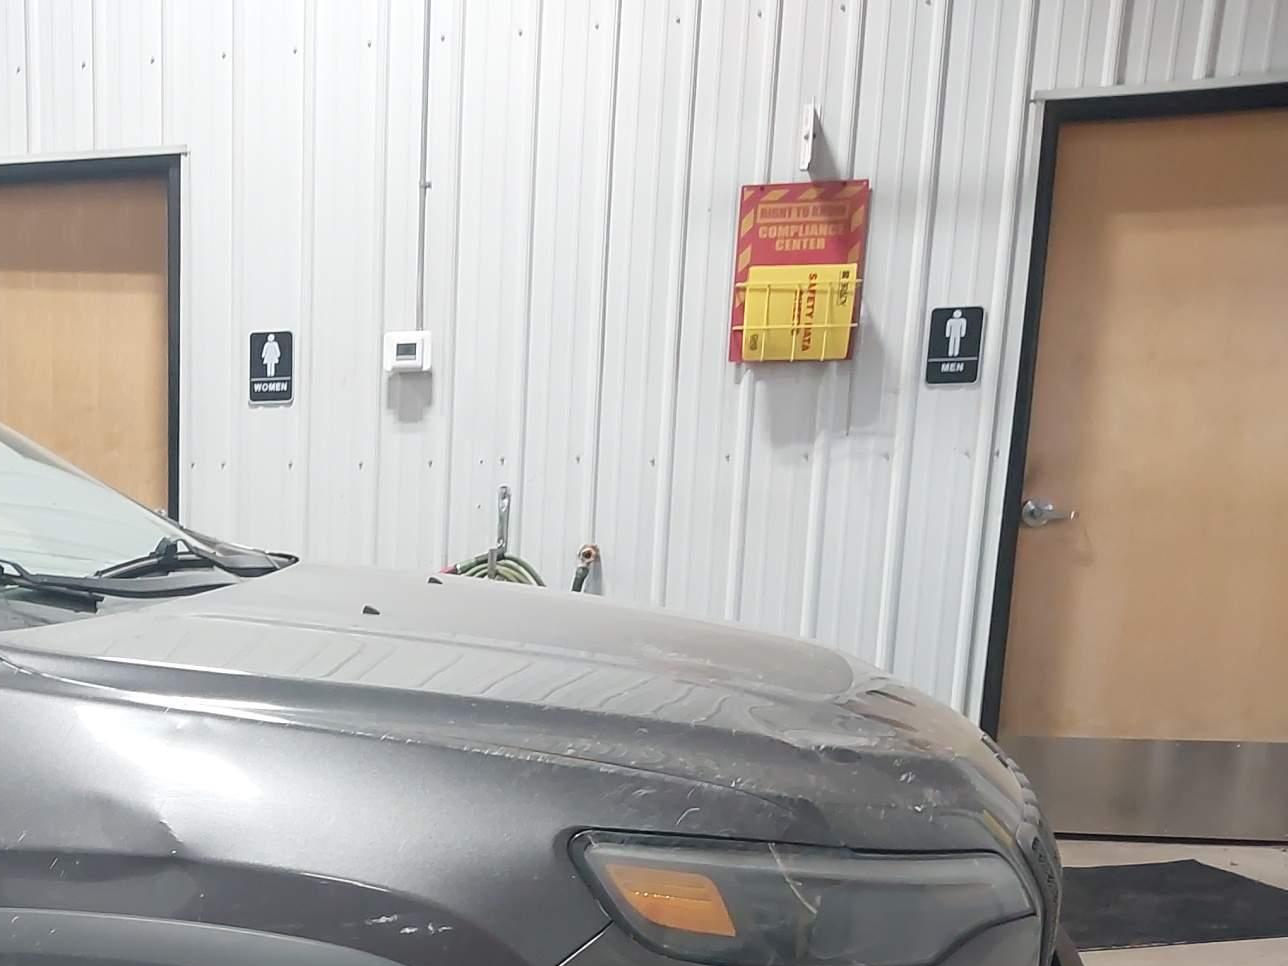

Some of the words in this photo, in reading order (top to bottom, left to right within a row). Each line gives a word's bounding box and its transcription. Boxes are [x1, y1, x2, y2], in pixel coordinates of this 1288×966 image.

[775, 238, 825, 251] CENTER
[941, 362, 964, 373] MEN
[253, 382, 288, 392] WOMEN
